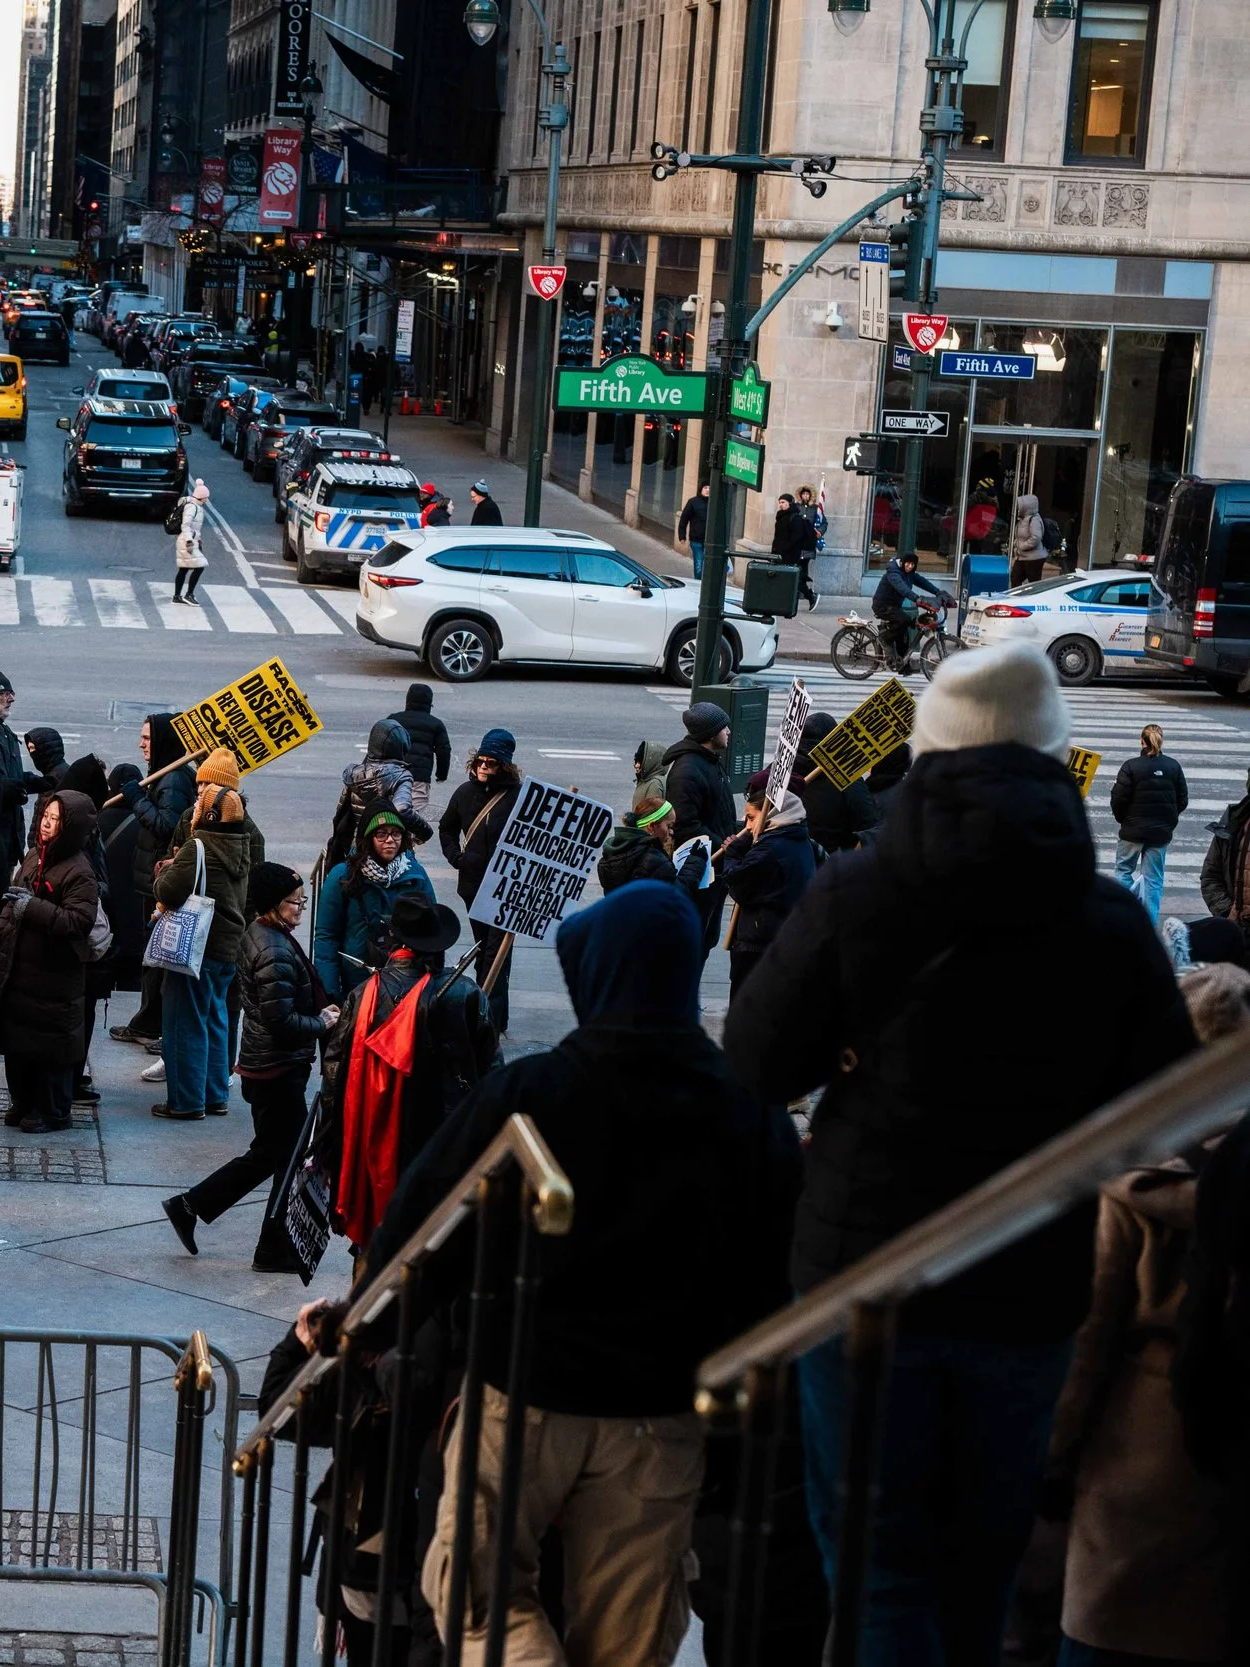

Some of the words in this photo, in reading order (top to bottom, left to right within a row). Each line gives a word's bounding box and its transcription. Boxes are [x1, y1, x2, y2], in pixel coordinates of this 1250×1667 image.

[268, 137, 299, 147] Library
[273, 146, 292, 156] Way
[910, 317, 930, 326] Library
[931, 318, 944, 326] Way
[628, 369, 645, 377] Library
[955, 357, 989, 372] Fifth
[993, 360, 1020, 374] Ave
[579, 379, 631, 403] Fifth
[638, 383, 683, 405] Ave
[733, 387, 746, 411] West
[756, 393, 763, 415] St
[888, 418, 906, 427] ONE
[915, 418, 935, 429] WAY
[268, 662, 319, 731] RACISM
[274, 688, 283, 698] IS
[281, 699, 296, 716] THE
[881, 681, 902, 702] THE
[237, 673, 301, 750] DISEASE
[854, 701, 875, 720] IS
[872, 694, 911, 738] SYSTEM
[214, 691, 272, 764] REVOLUTION
[230, 730, 240, 745] THE
[844, 719, 874, 749] SHUT
[868, 747, 882, 760] IT
[860, 708, 903, 751] GUILTY
[516, 781, 613, 849] DEFEND
[503, 820, 596, 874] DEMOCRACY:
[492, 849, 526, 881] IT'S
[523, 860, 561, 892] TIME
[556, 871, 588, 902] FOR
[492, 877, 506, 901] A
[507, 880, 567, 921] GENERAL
[494, 902, 552, 940] STRIKE!
